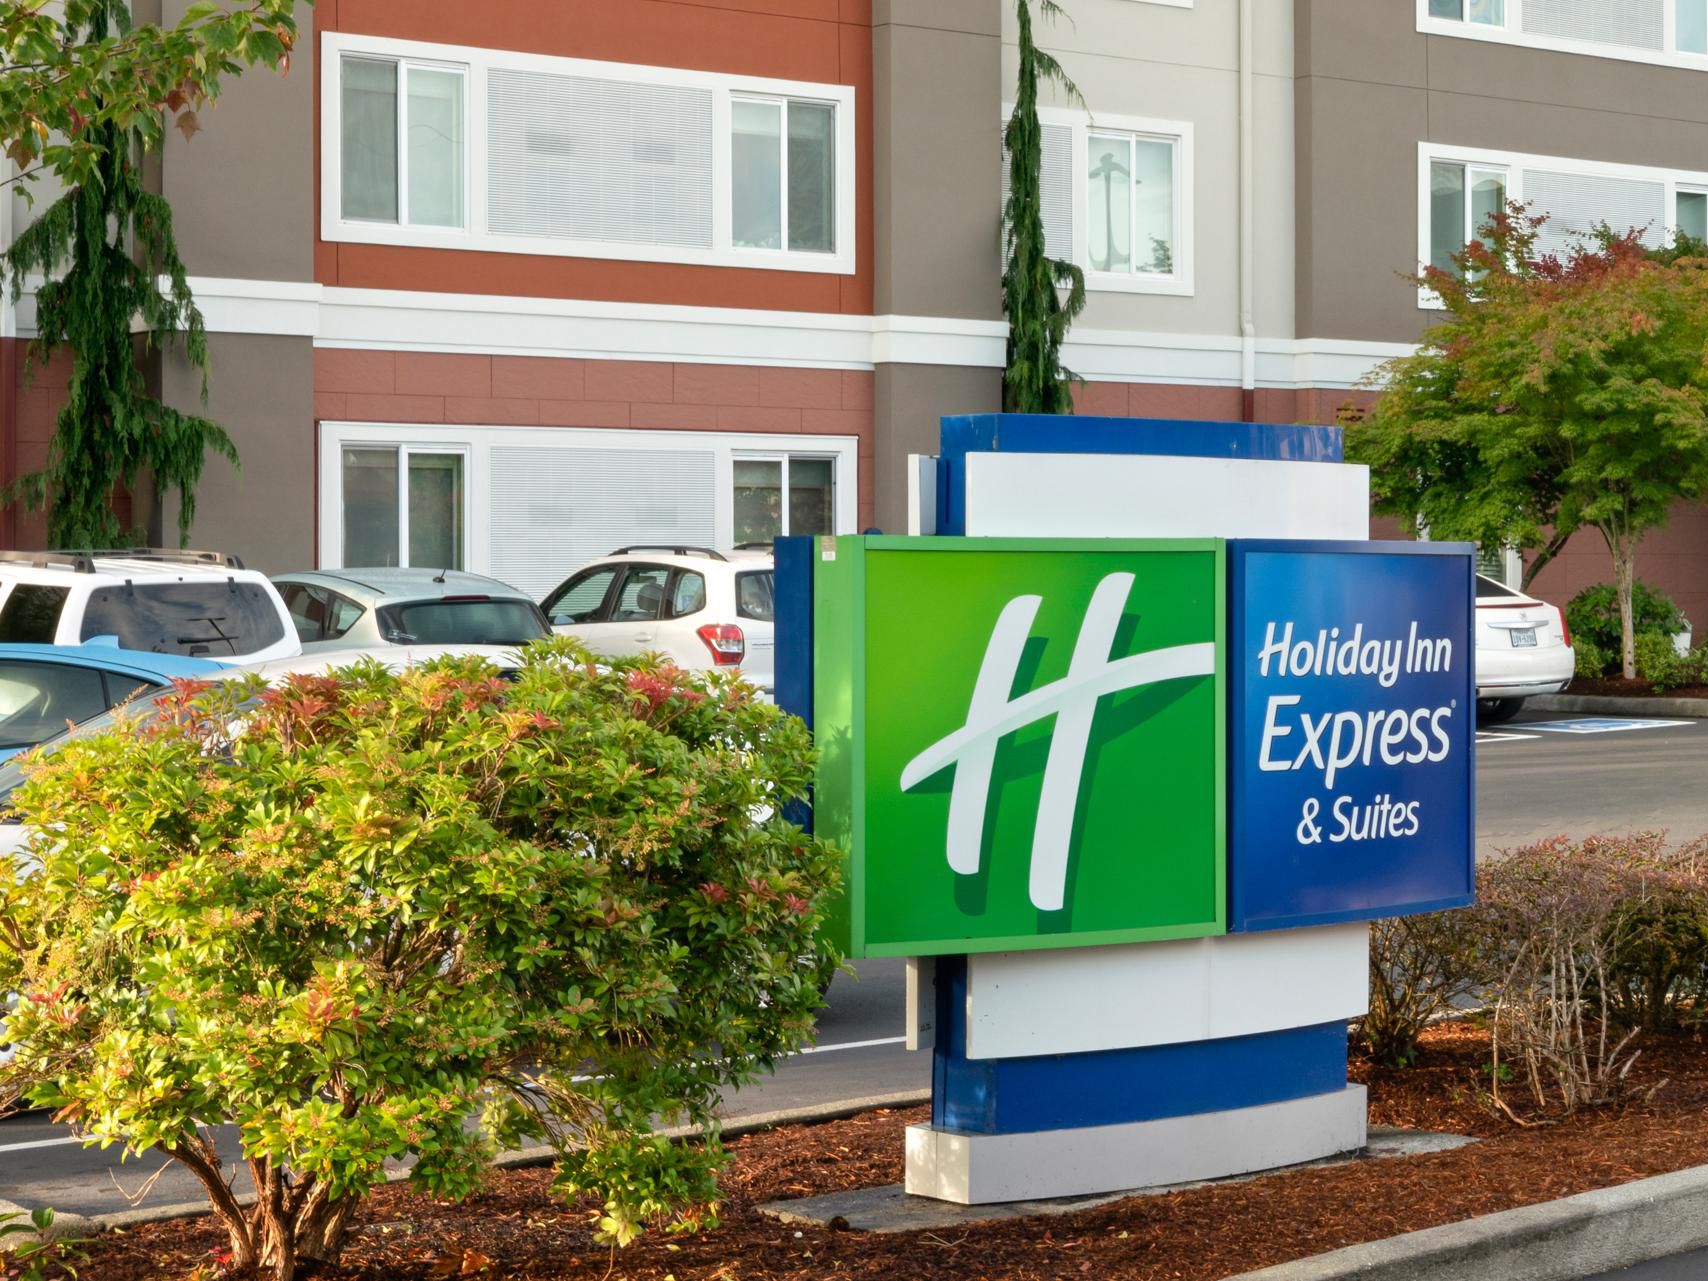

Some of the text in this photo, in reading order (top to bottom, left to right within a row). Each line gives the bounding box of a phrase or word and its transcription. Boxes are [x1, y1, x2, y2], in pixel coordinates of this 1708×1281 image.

[1257, 621, 1452, 688] Holiday Inn
[900, 572, 1215, 911] H
[1258, 695, 1453, 790] Express
[1296, 794, 1420, 845] & Suites
